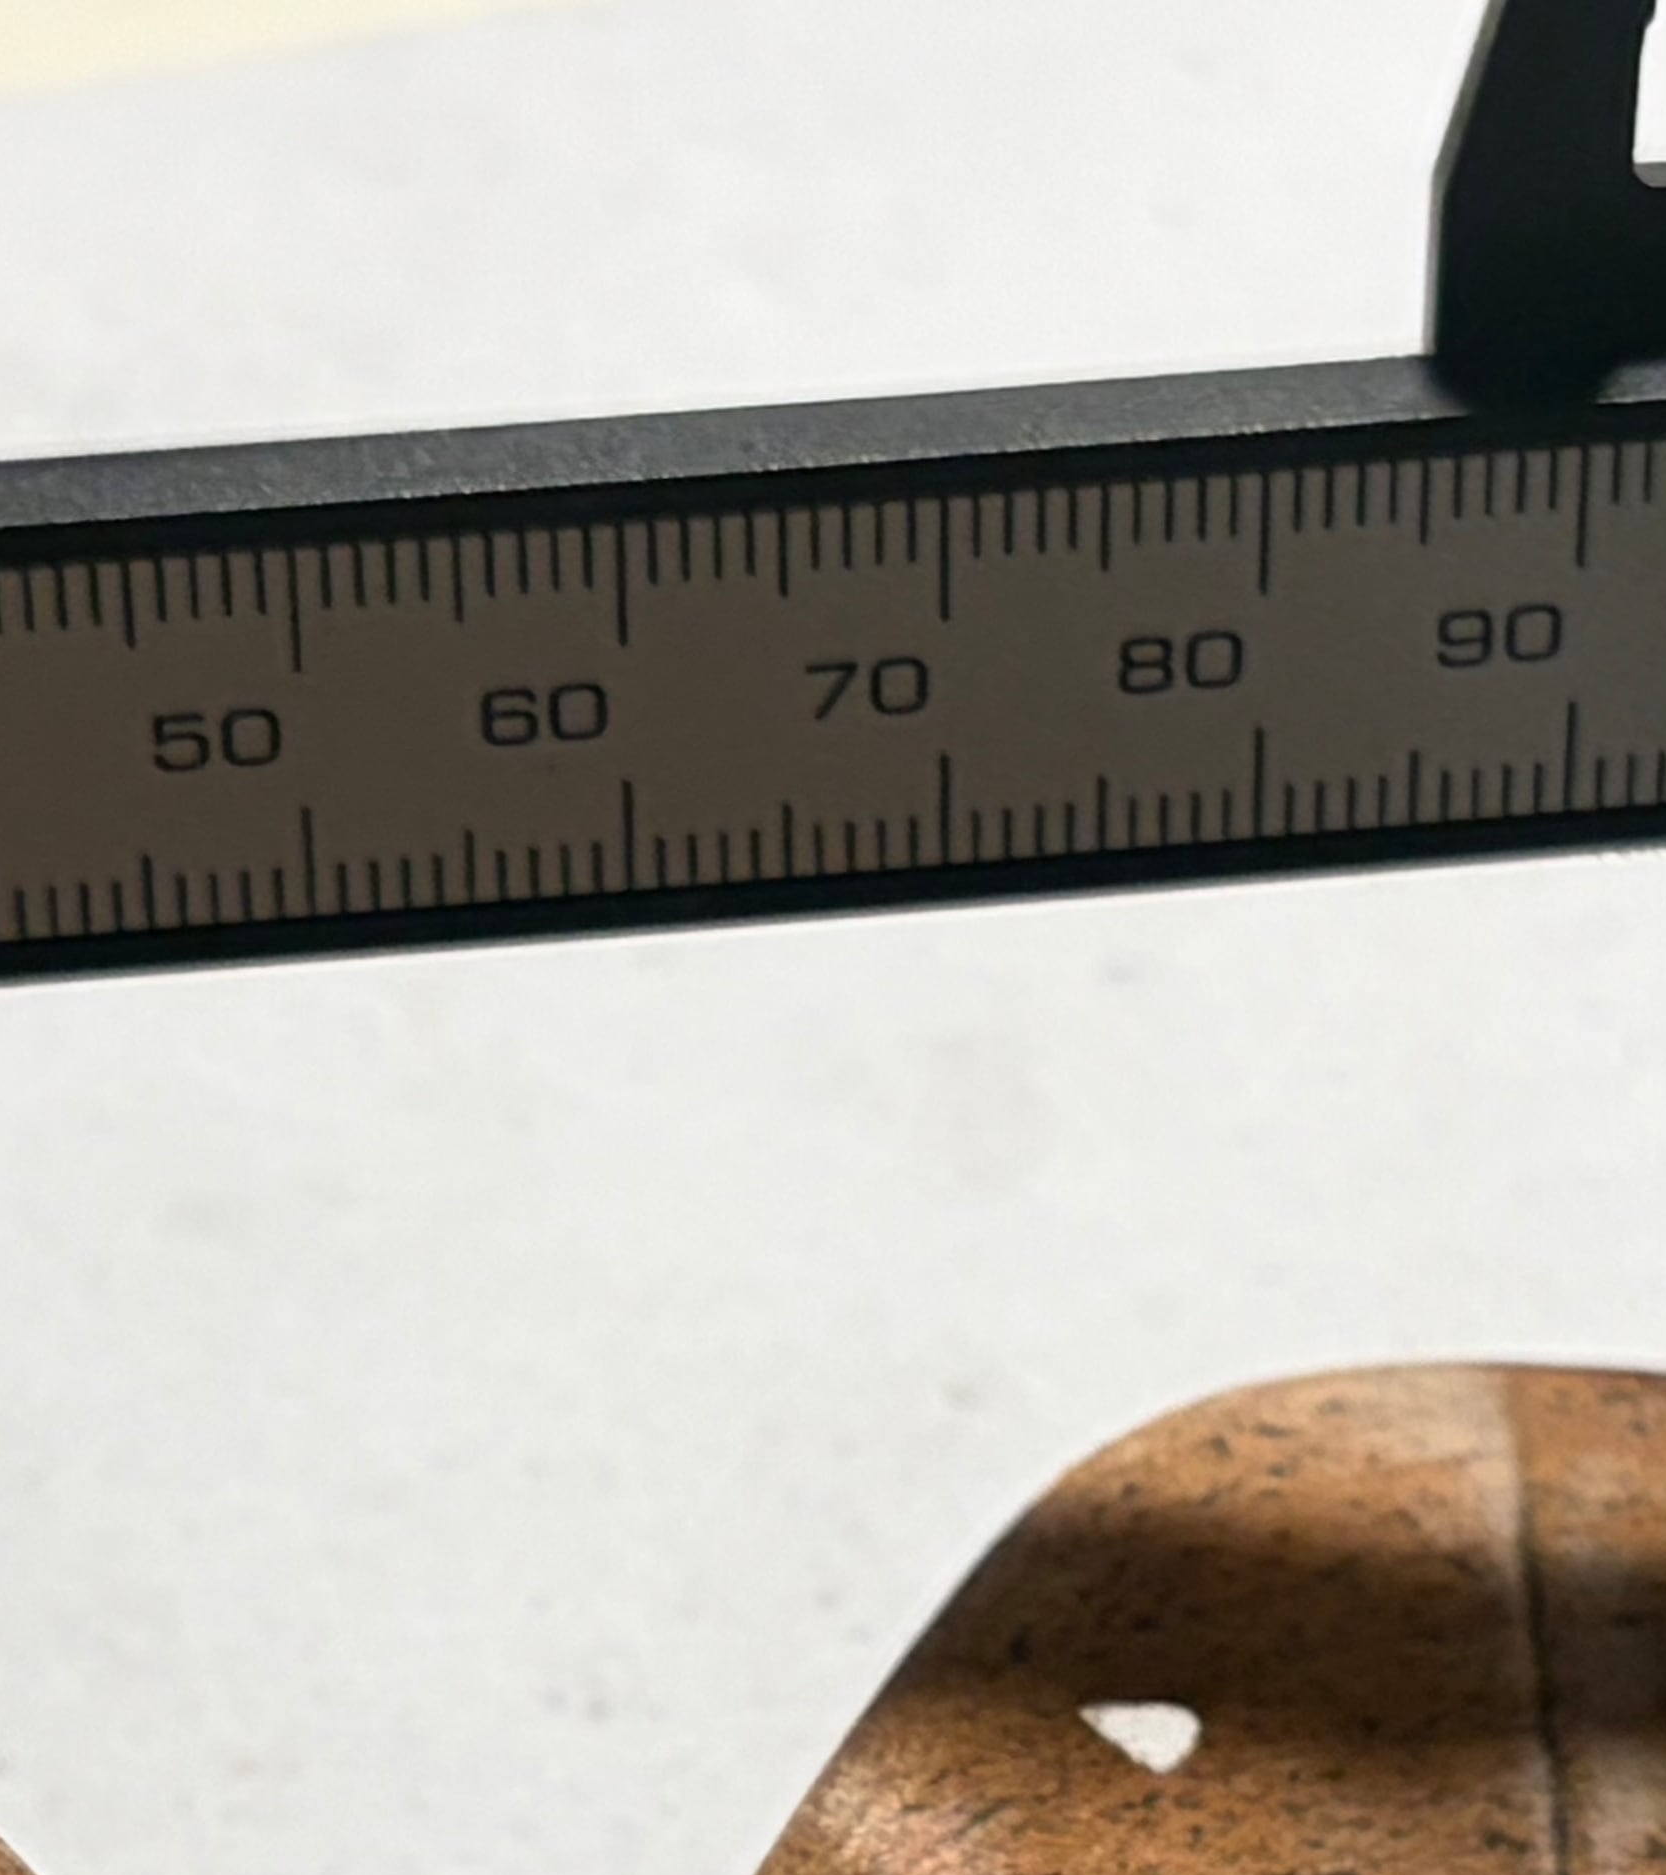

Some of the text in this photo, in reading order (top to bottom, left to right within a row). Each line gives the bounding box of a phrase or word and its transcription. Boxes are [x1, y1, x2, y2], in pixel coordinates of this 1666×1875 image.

[151, 708, 283, 772] 50
[479, 682, 609, 746] 60
[805, 656, 929, 720] 70
[1117, 631, 1245, 693] 80
[1435, 604, 1563, 668] 90
